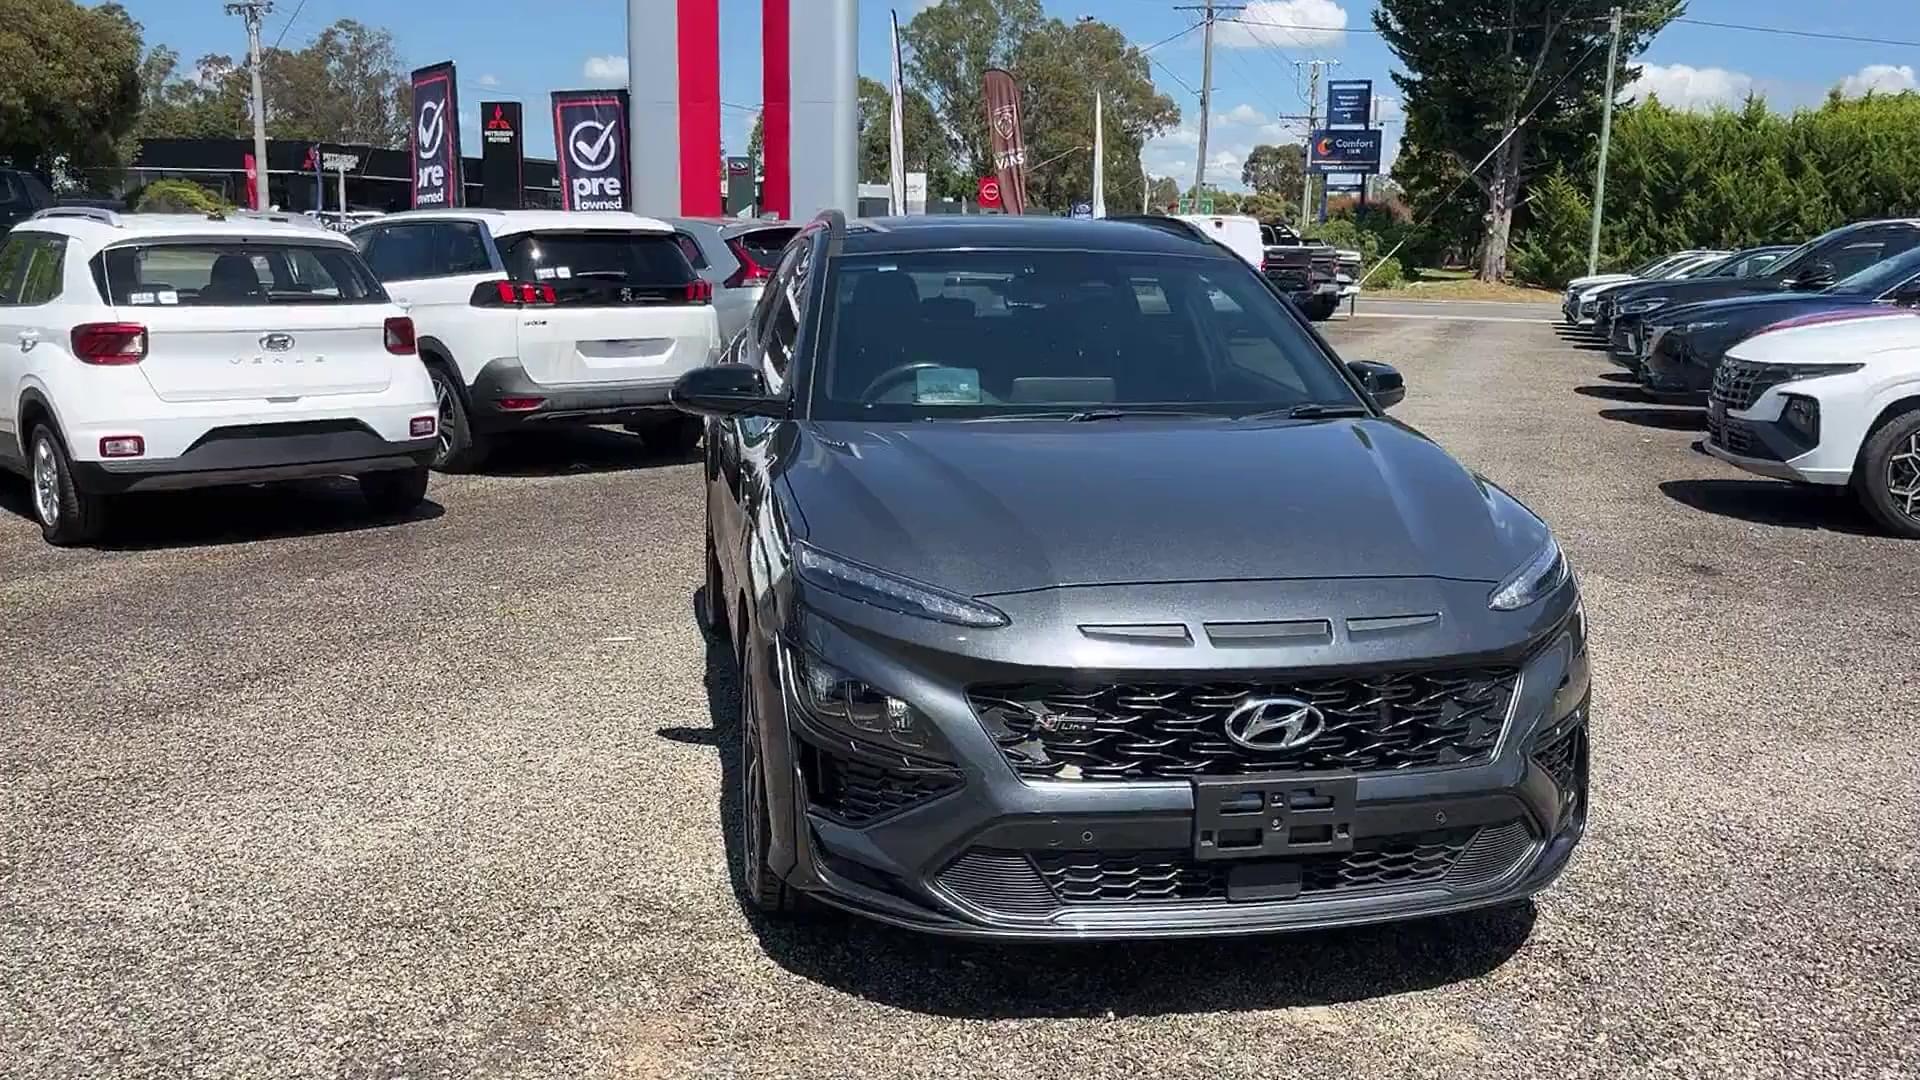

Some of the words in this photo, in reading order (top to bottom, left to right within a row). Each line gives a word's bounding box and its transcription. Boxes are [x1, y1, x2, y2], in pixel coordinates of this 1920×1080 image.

[1335, 138, 1374, 148] Comfort
[996, 152, 1024, 170] VANS
[572, 177, 621, 210] pre
[581, 197, 622, 210] owned
